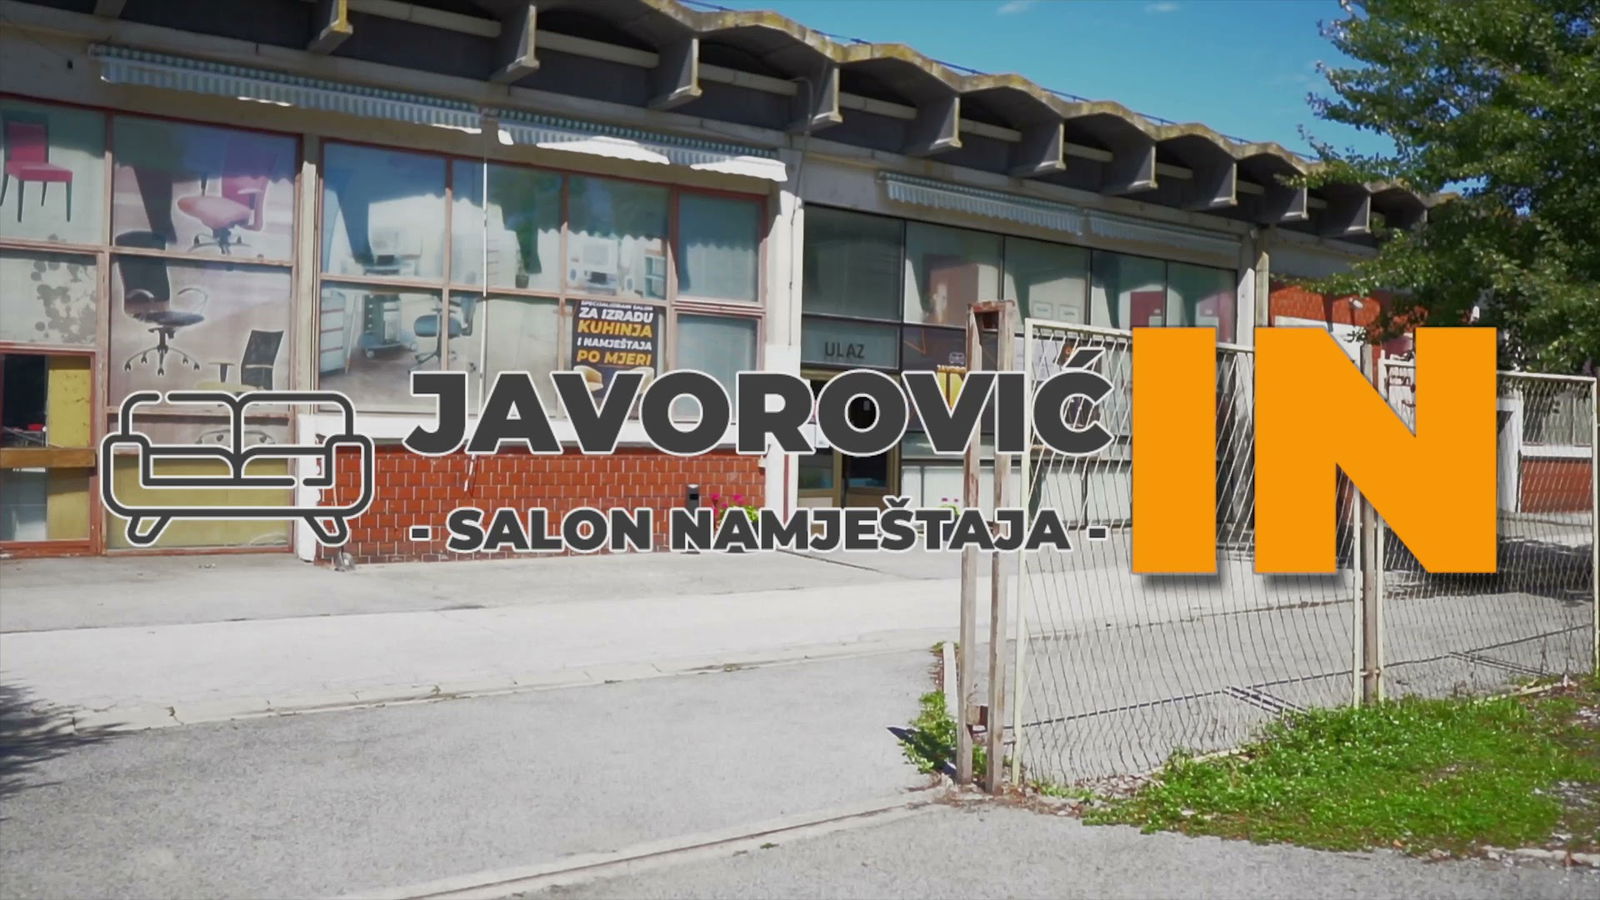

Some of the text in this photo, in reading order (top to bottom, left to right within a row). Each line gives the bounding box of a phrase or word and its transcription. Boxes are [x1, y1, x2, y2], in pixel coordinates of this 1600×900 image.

[578, 307, 654, 323] ZA IZRADU
[577, 320, 652, 338] KUHINJA
[577, 337, 652, 351] I NAMJEŠTAJA
[824, 341, 865, 359] ULAZ
[577, 350, 652, 366] PO MJERI
